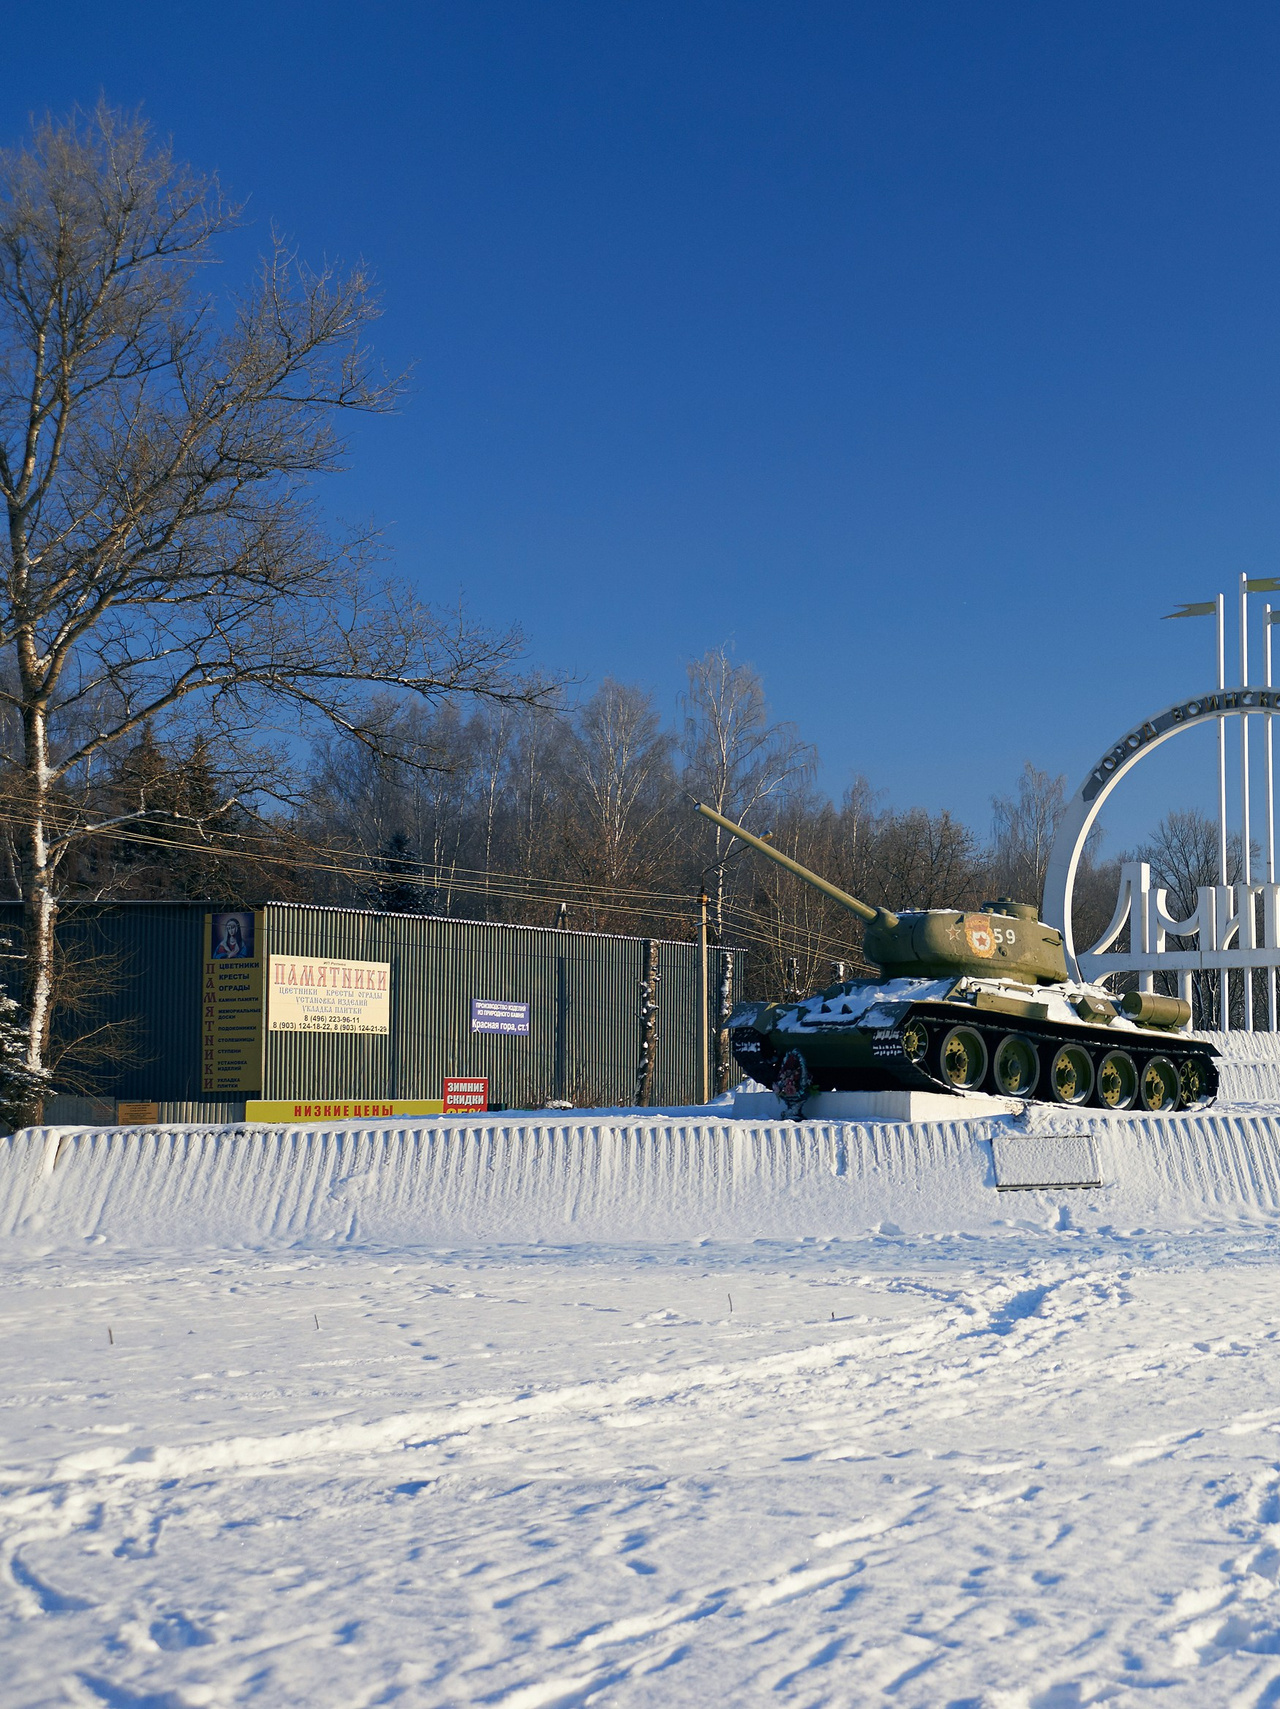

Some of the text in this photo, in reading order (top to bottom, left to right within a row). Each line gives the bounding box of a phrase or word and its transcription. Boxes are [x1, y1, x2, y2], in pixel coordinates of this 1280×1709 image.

[1092, 721, 1158, 782] ГОРОД
[993, 928, 1016, 945] 59
[219, 962, 260, 970] ЦВЕТНИКИ
[274, 963, 388, 992] ПАМЯТНИКИ
[279, 987, 318, 995] ЦВЕТНИКИ
[326, 989, 355, 997] КРЕСТЫ
[295, 996, 368, 1006] УСТАНОВКА ИЗДЕЛИЙ
[302, 1005, 333, 1013] УКЛАДКА
[310, 1015, 328, 1023] (496)
[203, 963, 217, 1089] ПАМЯТНИКИ
[272, 1021, 278, 1029] 8
[279, 1022, 297, 1030] (903)
[299, 1022, 333, 1031] 124-18-22,
[339, 1024, 357, 1032] (903)
[472, 1018, 500, 1030] Красная
[500, 1022, 517, 1032] гора,
[447, 1082, 485, 1093] ЗИМНИЕ
[446, 1094, 485, 1106] СКИДКИ
[294, 1105, 394, 1118] НИЗКИЕ ЦЕНЫ
